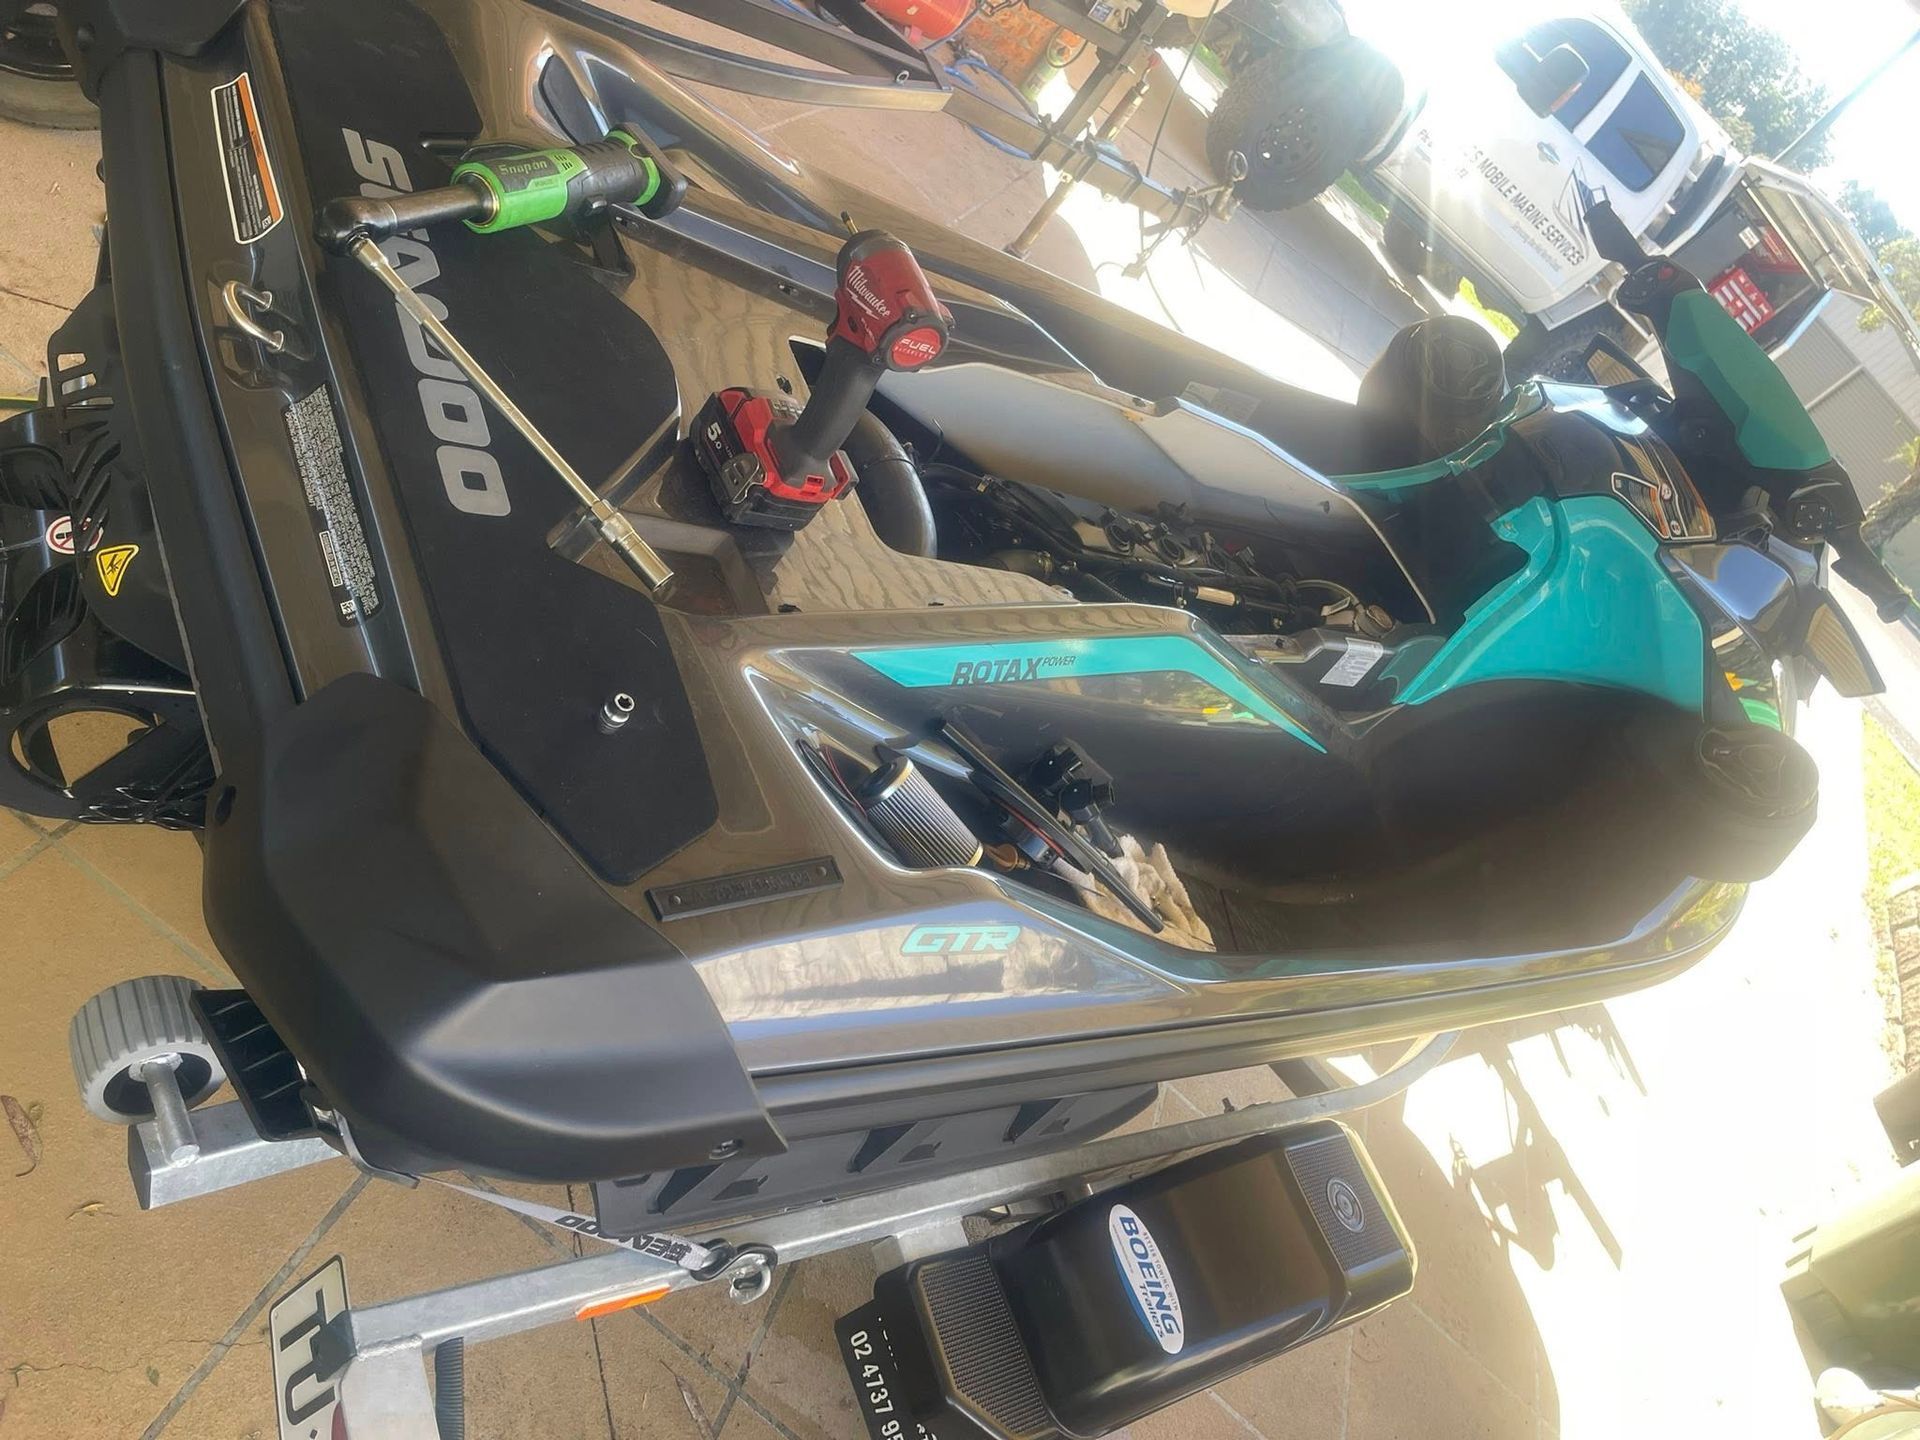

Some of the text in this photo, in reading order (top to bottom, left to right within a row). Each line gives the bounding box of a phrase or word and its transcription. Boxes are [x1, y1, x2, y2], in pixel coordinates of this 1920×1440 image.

[1477, 158, 1517, 198] MOBILE
[1510, 192, 1549, 230] MARINE
[1541, 225, 1585, 266] SERVICES
[848, 265, 891, 316] Milwaukee
[900, 338, 936, 355] FUEL
[951, 656, 1076, 687] ROTAX POWER
[901, 925, 1021, 953] GTR
[1120, 1217, 1181, 1335] BOEING
[1155, 1259, 1169, 1290] TOWING
[1167, 1290, 1179, 1311] WITH
[1139, 1283, 1164, 1338] Trailers
[850, 1330, 873, 1360] 02
[863, 1364, 894, 1414] 4737
